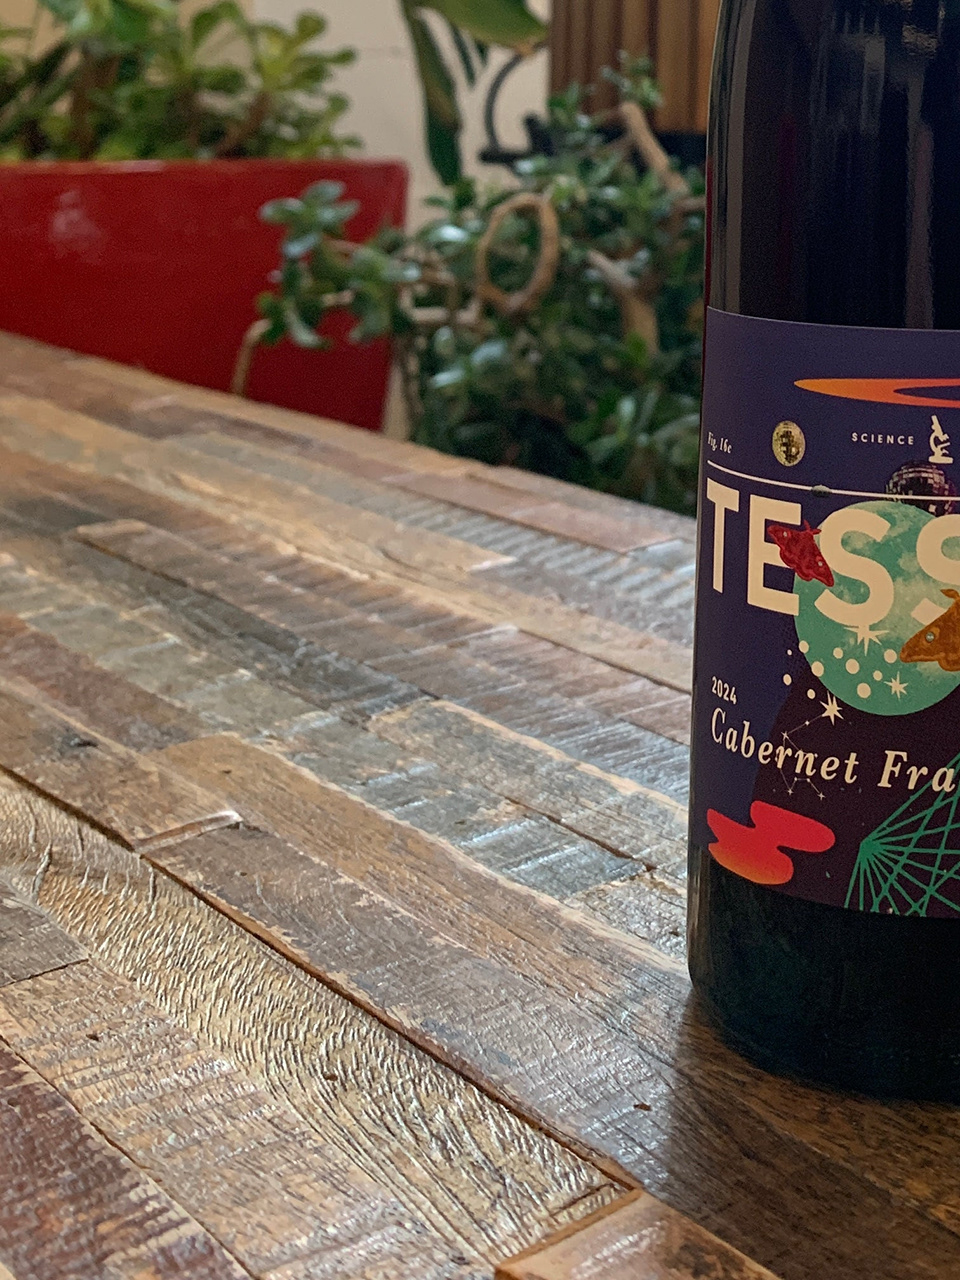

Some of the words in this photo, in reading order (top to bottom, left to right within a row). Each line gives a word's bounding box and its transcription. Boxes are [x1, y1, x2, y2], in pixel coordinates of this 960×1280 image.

[851, 432, 914, 446] SCIENCE
[711, 675, 738, 705] 2024
[711, 707, 860, 785] Cabernet
